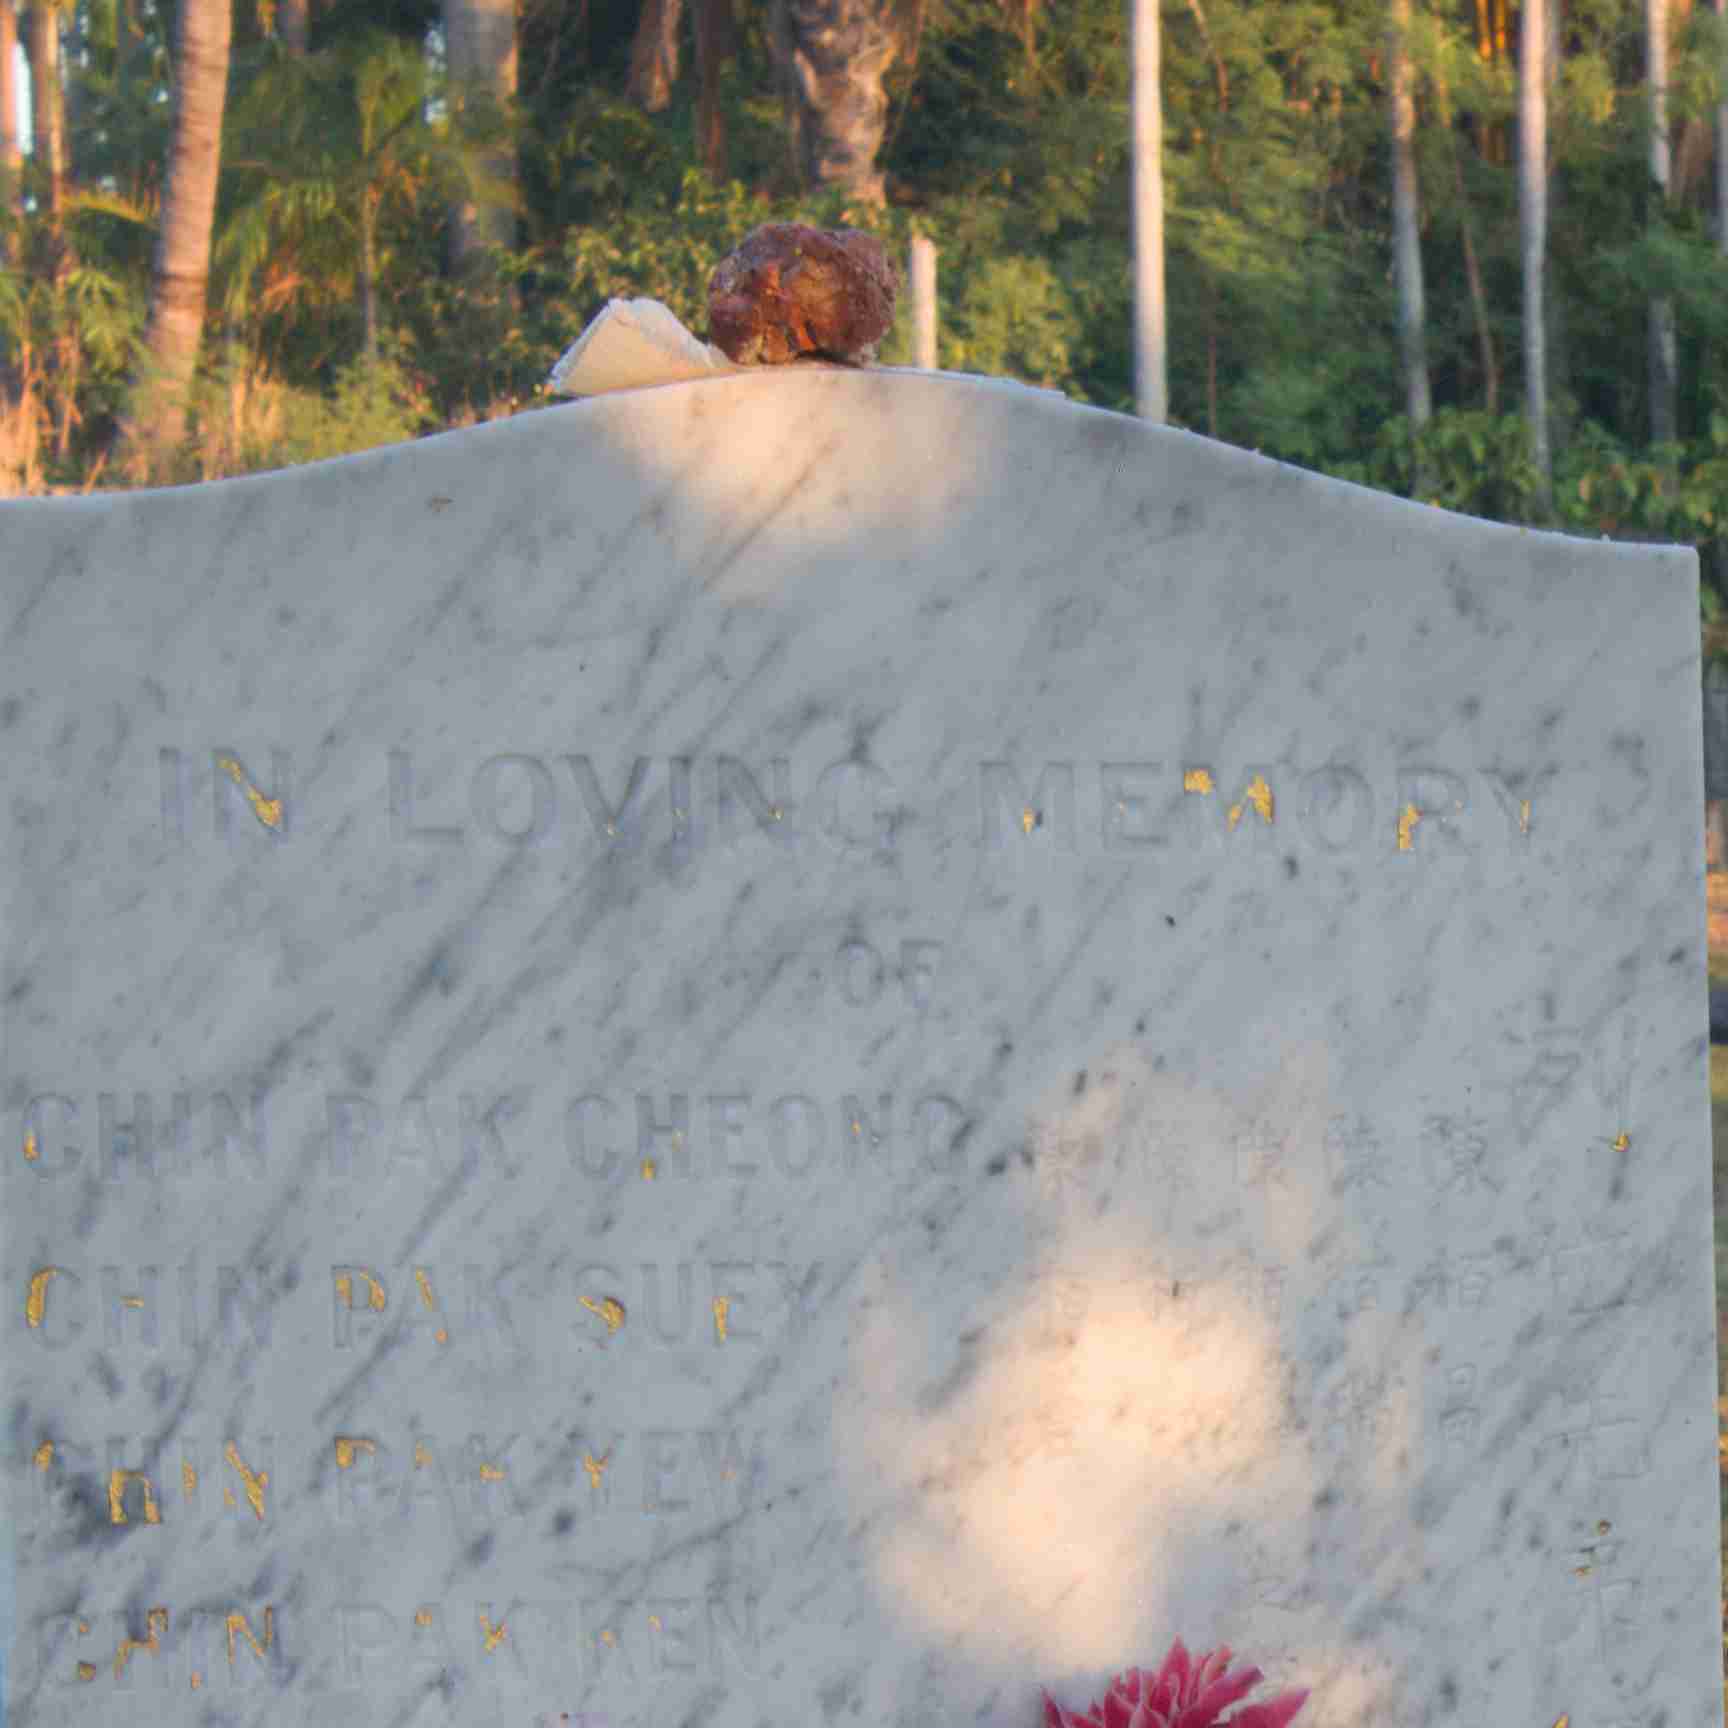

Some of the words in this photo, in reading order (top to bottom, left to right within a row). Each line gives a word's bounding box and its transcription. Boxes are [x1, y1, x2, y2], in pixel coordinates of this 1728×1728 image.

[157, 744, 293, 844] IN
[386, 749, 915, 853] LOVING
[979, 761, 1558, 852] MEMORY
[836, 938, 946, 1007] OF
[25, 1263, 274, 1351] CHIN
